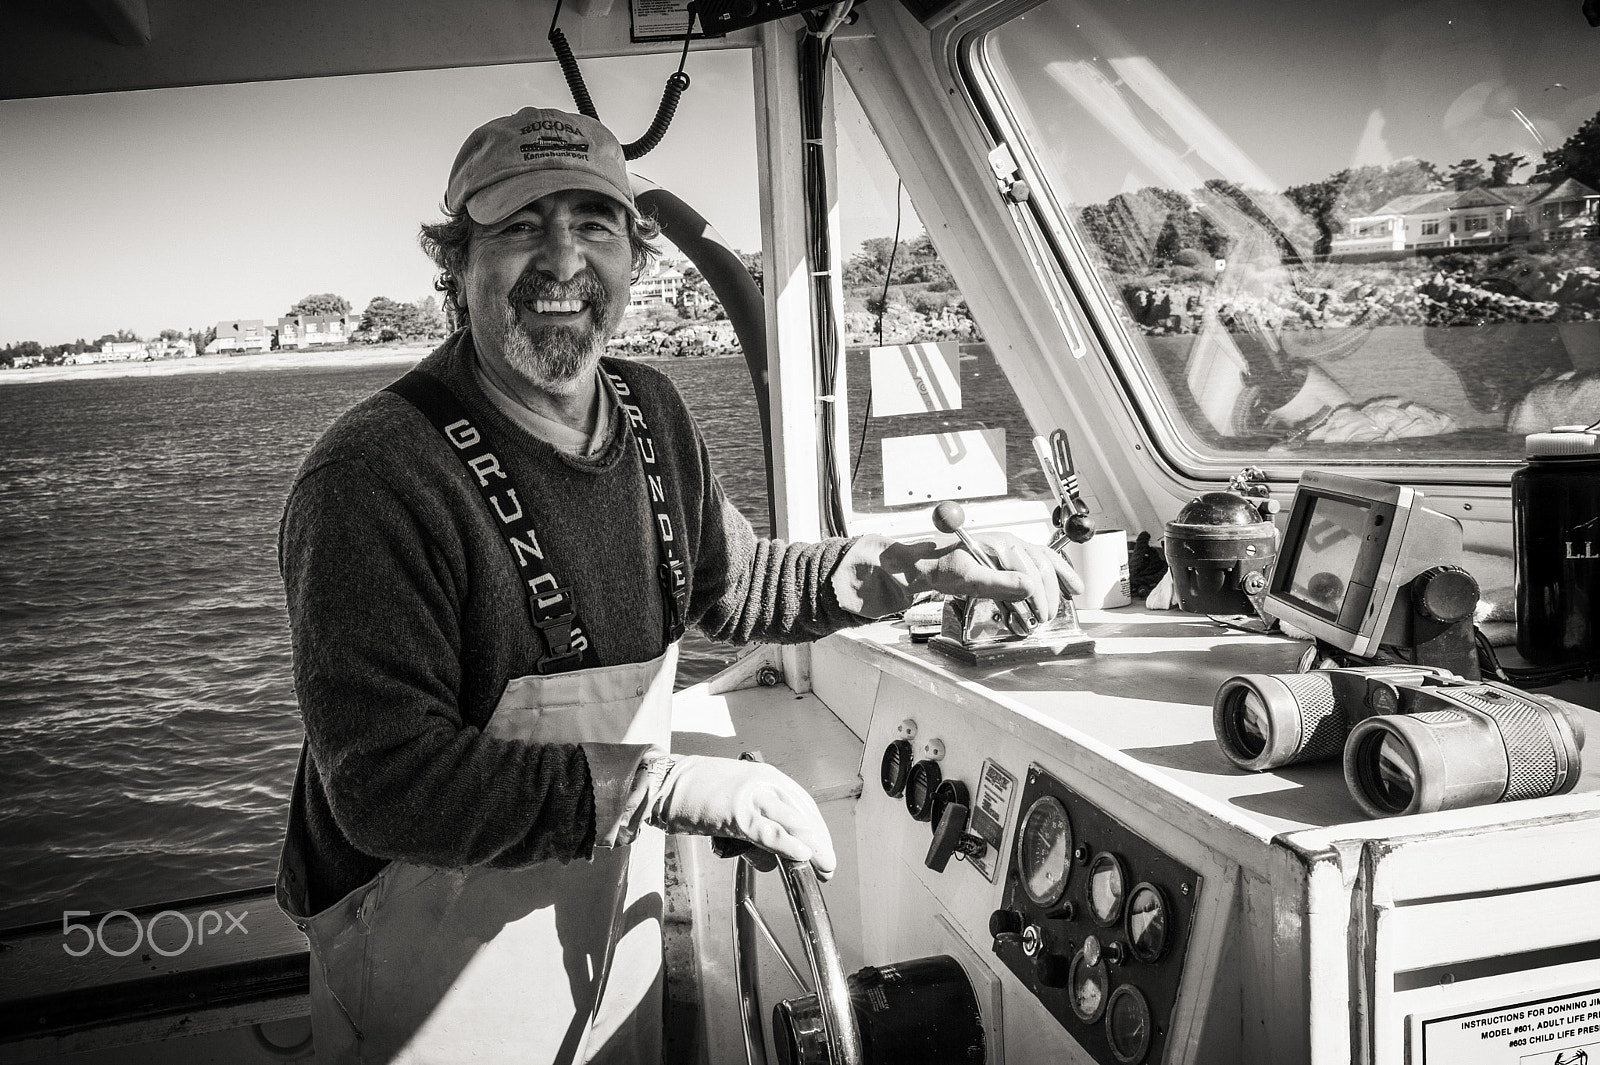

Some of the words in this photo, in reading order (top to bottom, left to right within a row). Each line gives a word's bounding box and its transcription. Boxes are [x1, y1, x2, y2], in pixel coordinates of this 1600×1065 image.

[520, 120, 584, 137] RUGOSA
[523, 151, 589, 161] Kennebunkport
[1461, 1011, 1525, 1030] INSTRUCTIONS
[1527, 1008, 1545, 1018] FOR
[1547, 1000, 1587, 1014] DONNING
[1481, 1028, 1512, 1040] MODEL
[1537, 1017, 1565, 1030] ADULT
[1567, 1013, 1585, 1024] LIFE
[1587, 1010, 1600, 1020] PR
[1529, 1033, 1555, 1044] CHILD
[1557, 1029, 1575, 1039] LIFE
